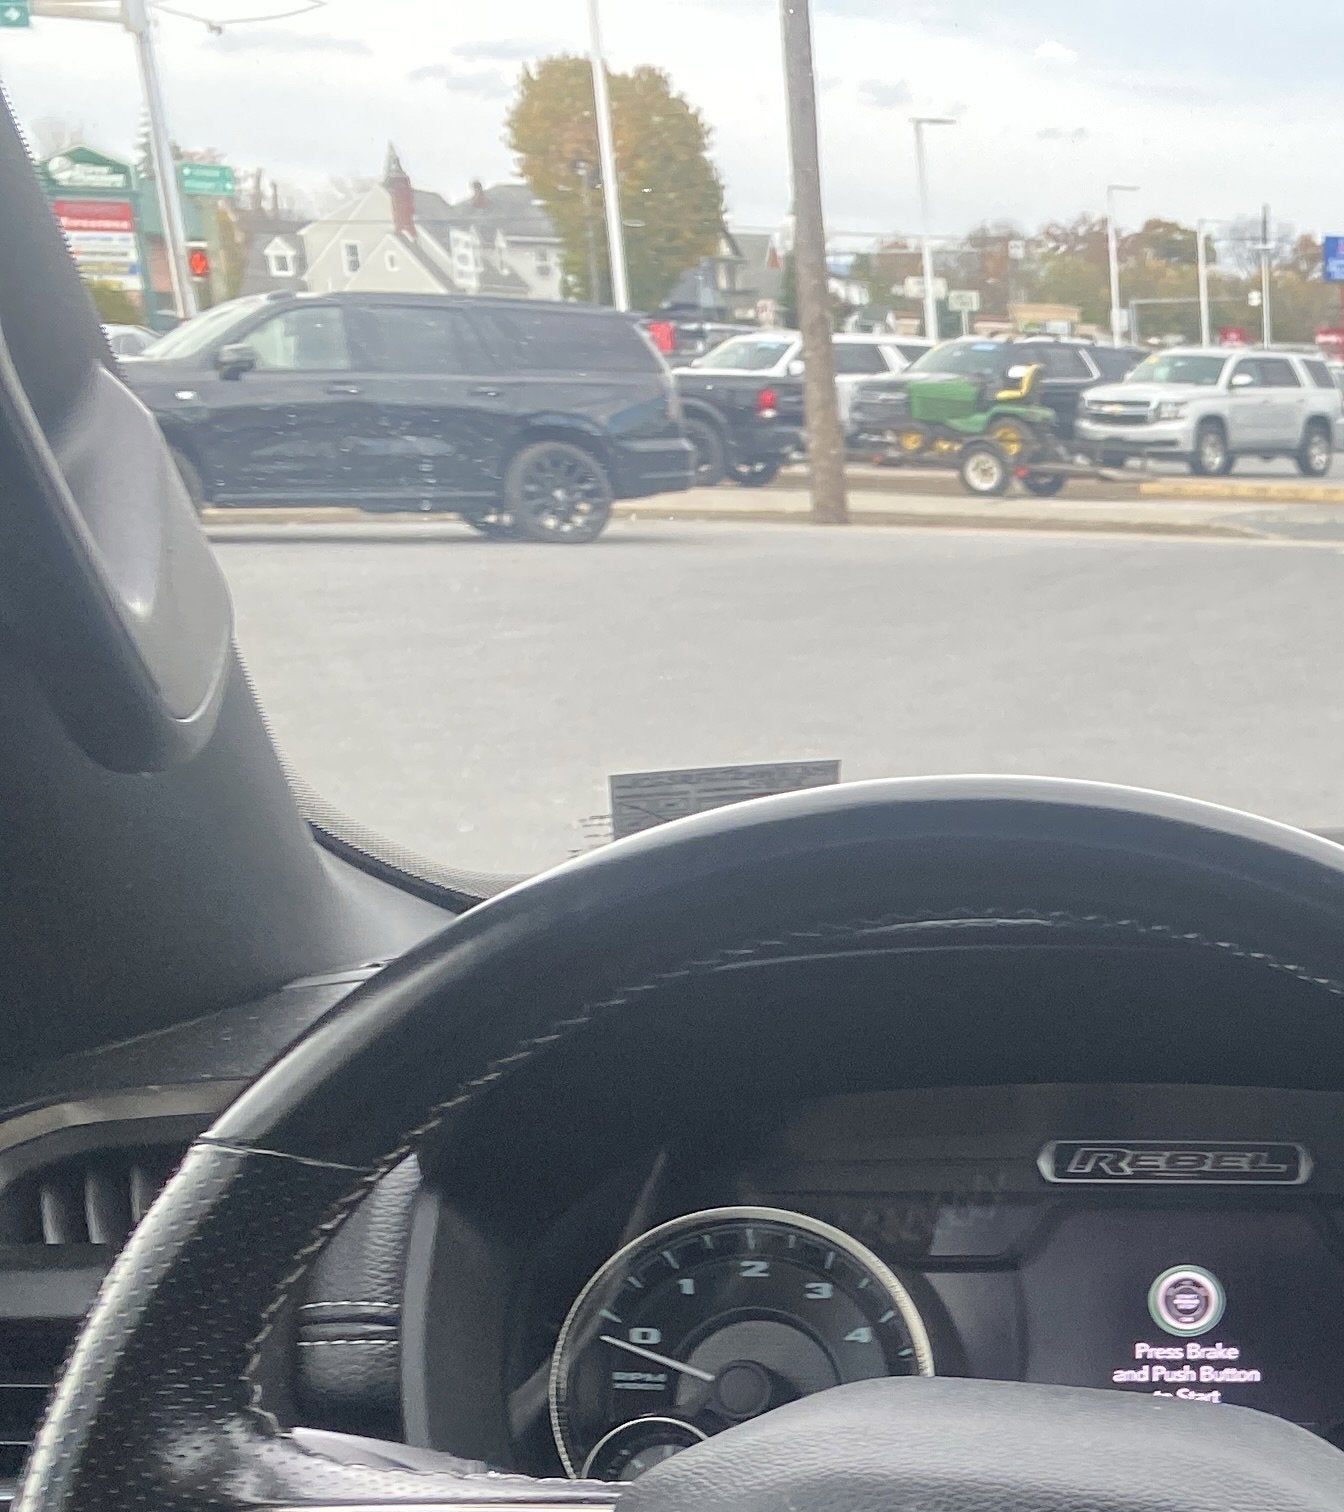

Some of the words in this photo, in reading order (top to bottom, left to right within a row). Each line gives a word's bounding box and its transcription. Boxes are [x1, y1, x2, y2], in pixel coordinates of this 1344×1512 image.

[1066, 1147, 1288, 1177] REBEL
[739, 1260, 770, 1278] 2
[677, 1277, 696, 1296] 1
[804, 1281, 834, 1300] 3
[628, 1327, 662, 1344] 0
[843, 1326, 873, 1344] 4
[1134, 1342, 1184, 1360] Press
[1186, 1342, 1240, 1360] Brake
[1112, 1365, 1149, 1383] and
[1151, 1365, 1196, 1383] Push
[1199, 1365, 1262, 1383] Button
